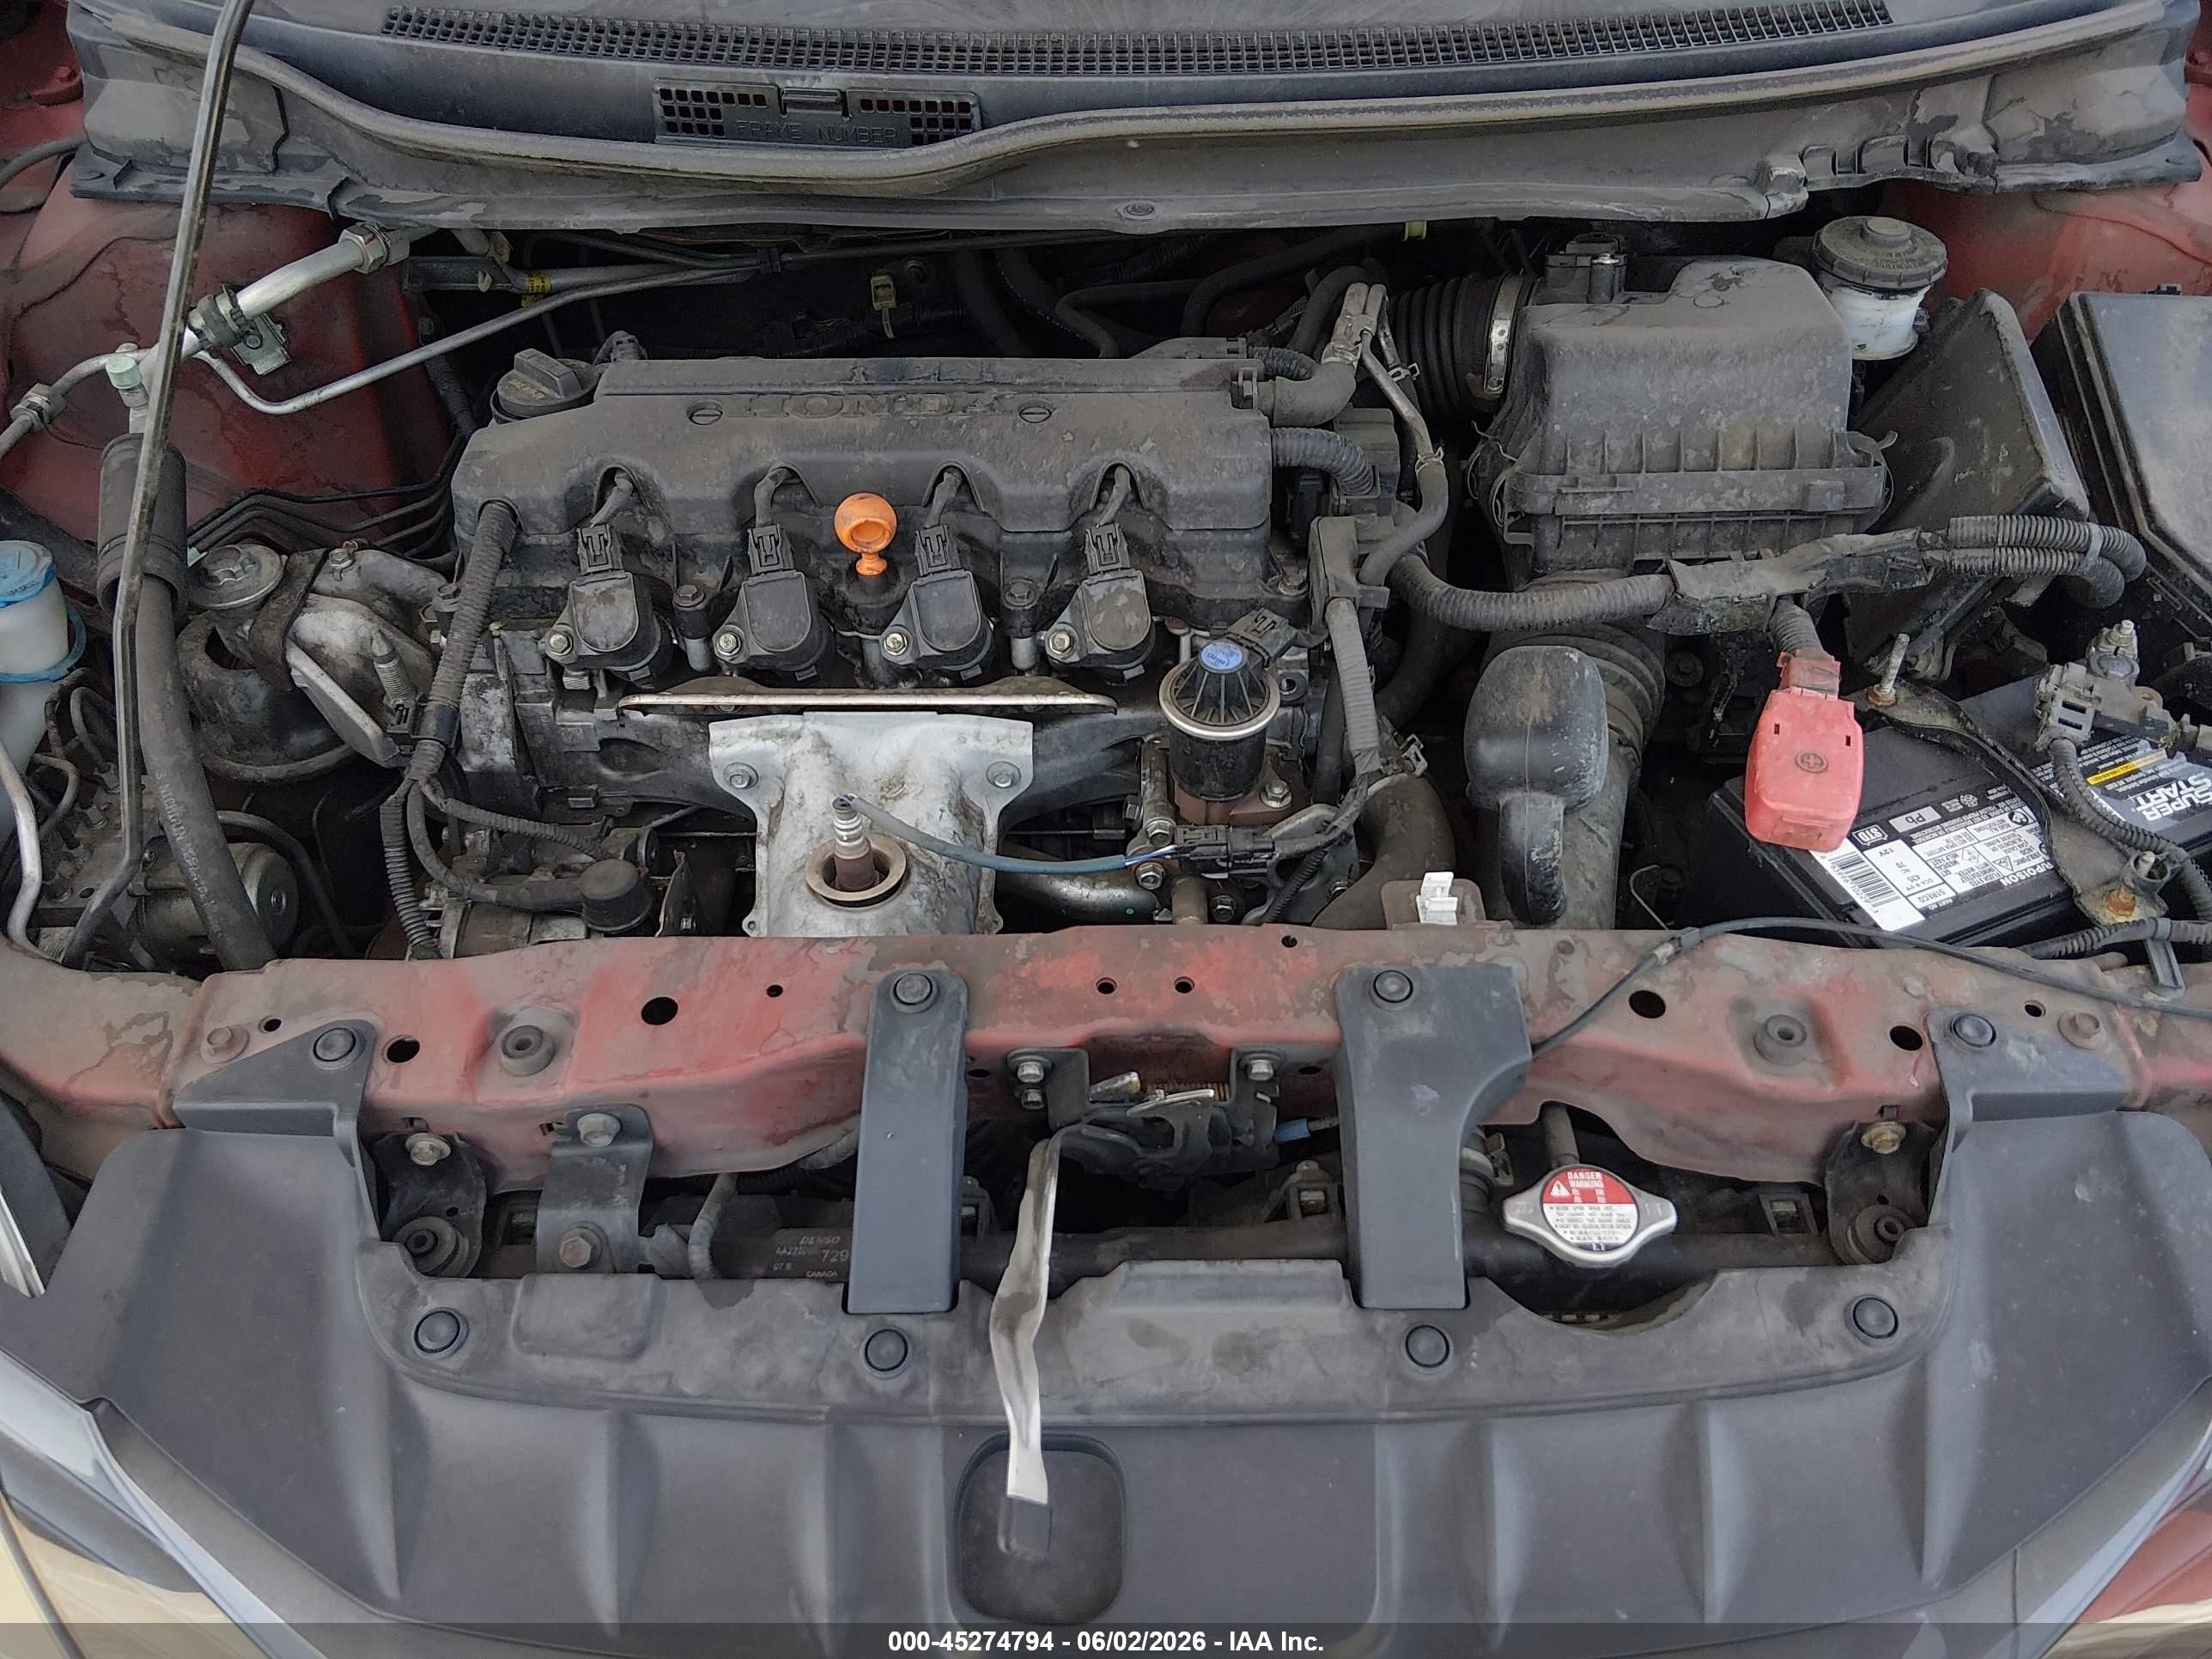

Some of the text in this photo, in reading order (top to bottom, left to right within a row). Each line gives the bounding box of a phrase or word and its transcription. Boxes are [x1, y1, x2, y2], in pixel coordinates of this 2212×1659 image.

[734, 119, 898, 144] FRAME NUMBER
[727, 393, 1012, 419] HONDA
[2136, 771, 2212, 812] START
[2143, 790, 2212, 822] SUPER
[1903, 812, 1927, 826] Pb
[1856, 826, 1883, 842] STD
[1876, 847, 1895, 856] 12V
[1933, 859, 1960, 871] MEDICAL
[1905, 873, 1922, 882] 435
[1998, 861, 2054, 885] R/POISON
[1567, 1171, 1602, 1180] DANGER
[1569, 1180, 1604, 1188] WARNING
[799, 1235, 842, 1244] DENSO
[1591, 1242, 1606, 1251] 1.1
